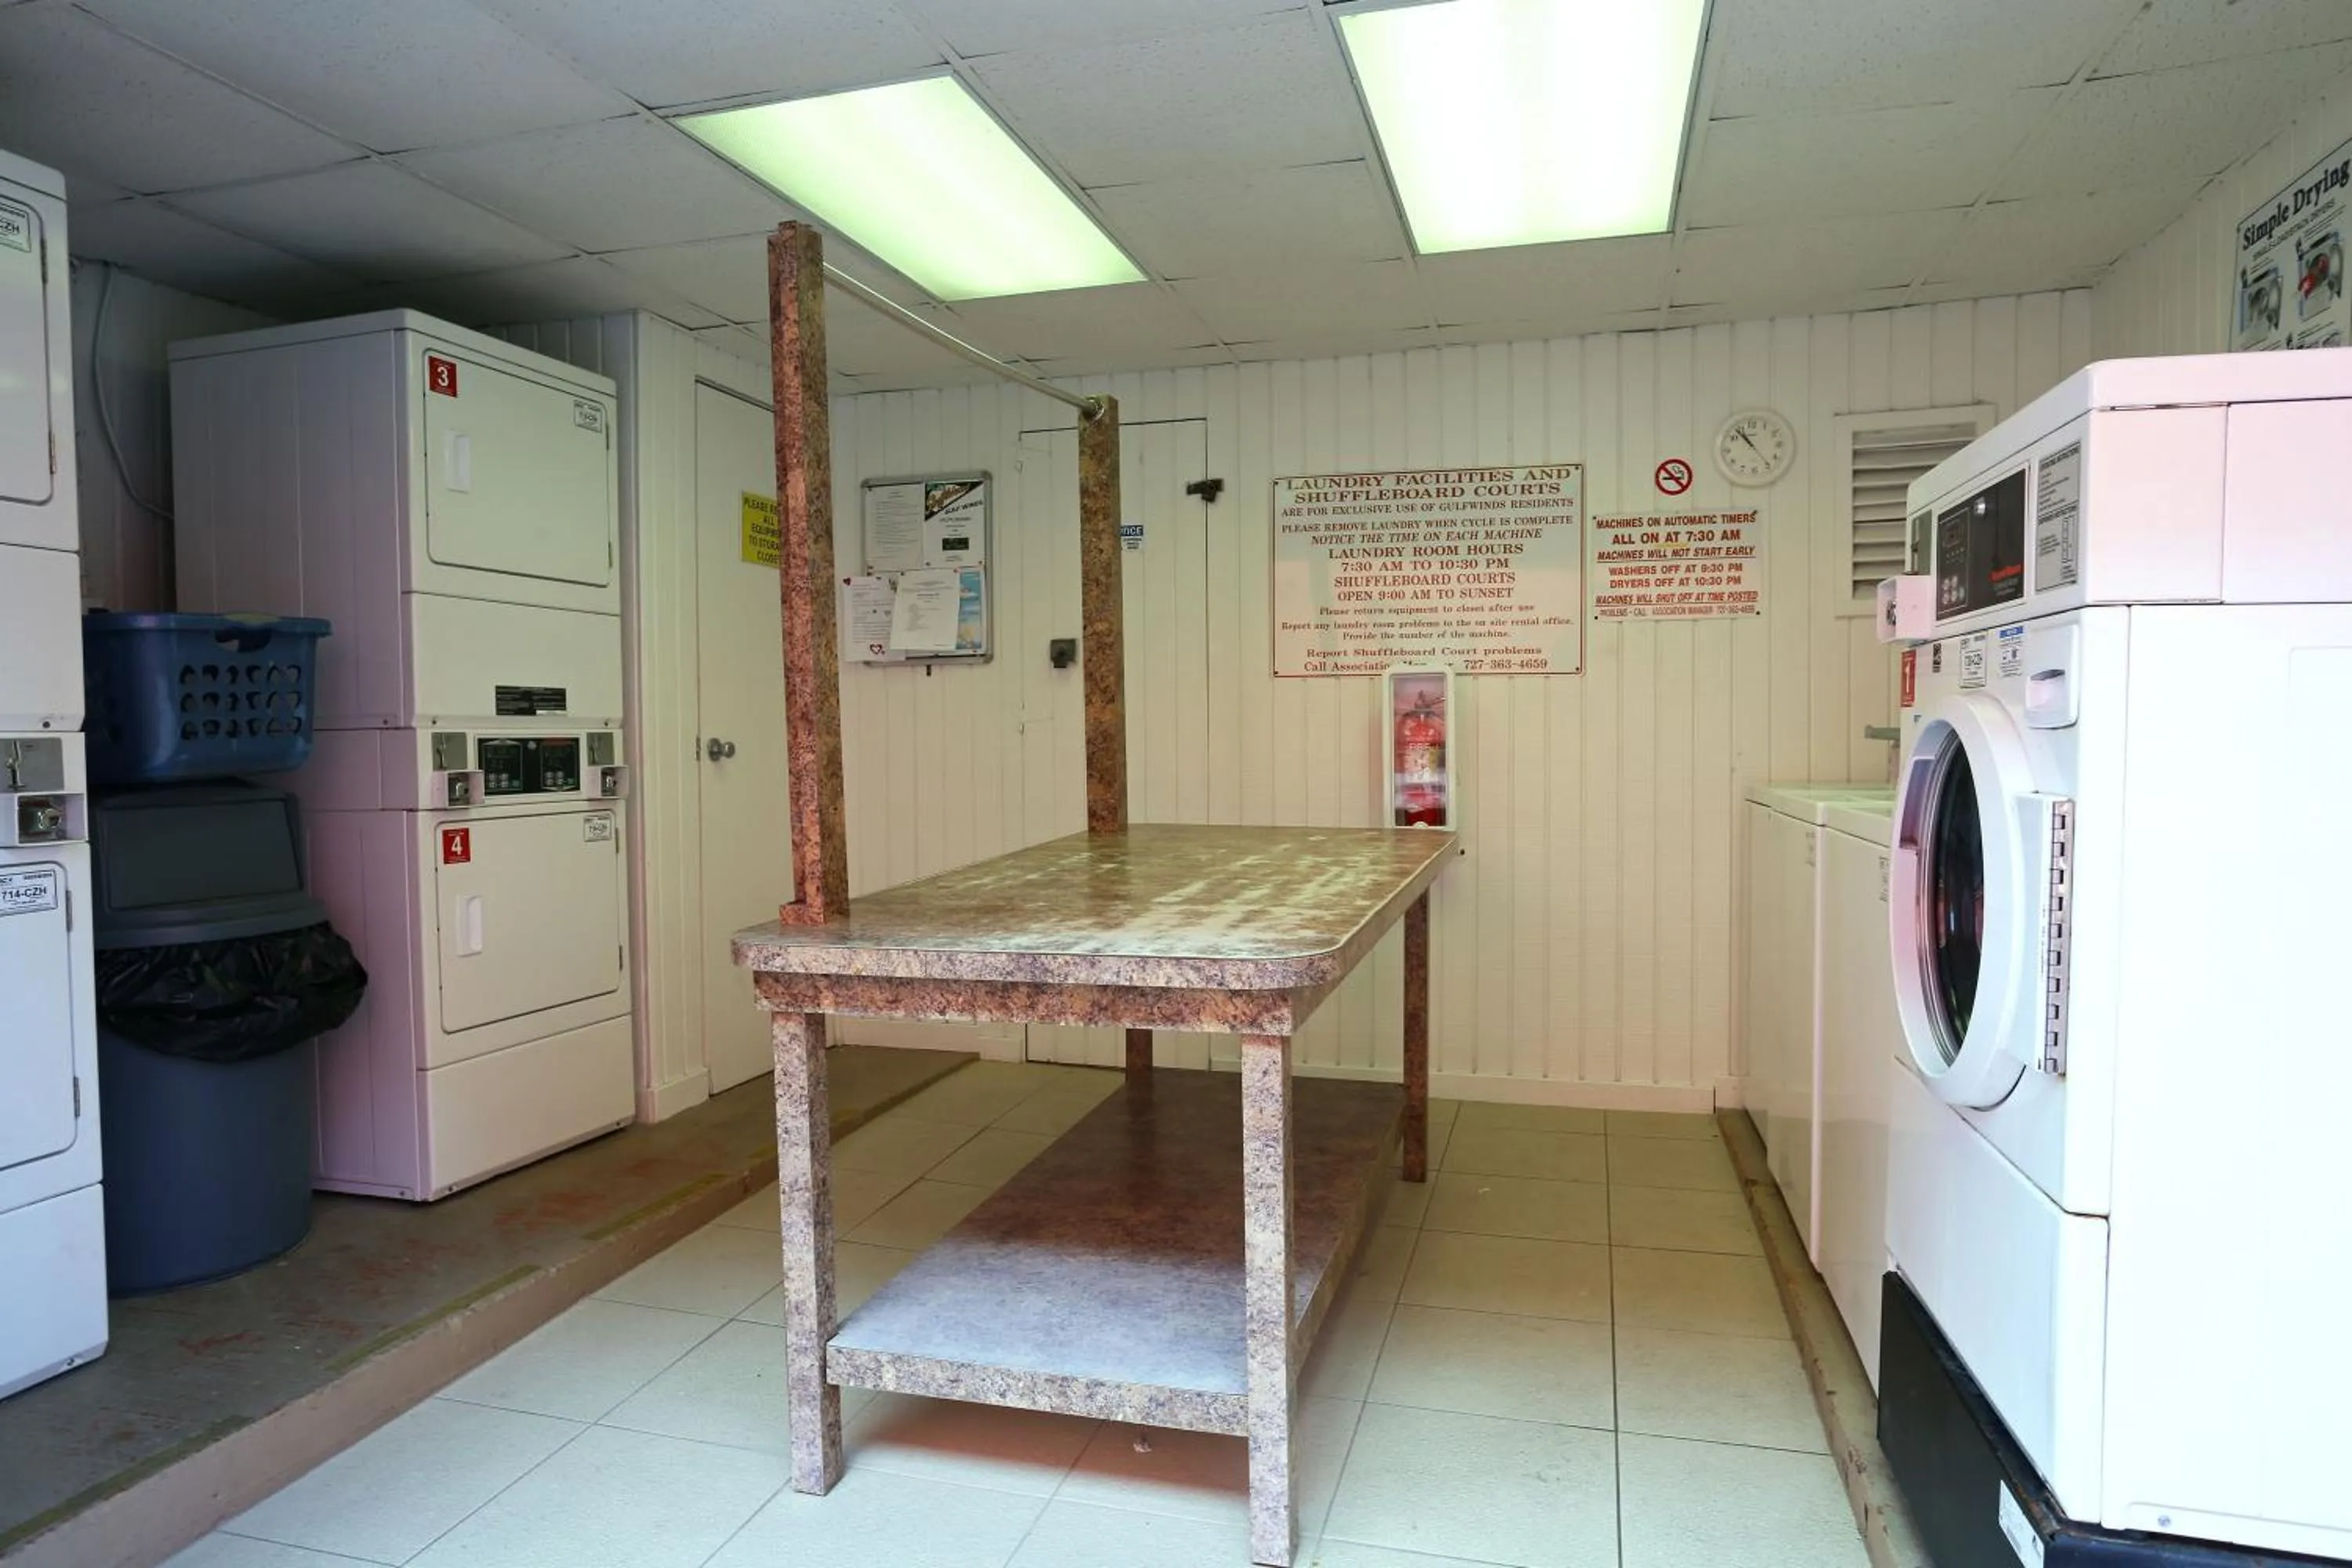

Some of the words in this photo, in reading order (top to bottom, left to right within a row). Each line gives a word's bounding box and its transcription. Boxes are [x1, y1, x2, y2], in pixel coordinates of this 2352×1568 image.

[2243, 202, 2289, 251] Simple
[2292, 158, 2350, 215] Drying
[437, 366, 448, 387] 3
[1287, 476, 1385, 490] LAUNDRY
[1394, 470, 1514, 485] FACILITIES
[1524, 468, 1571, 481] AND
[1294, 486, 1465, 503] SHUFFLEBOARD
[1474, 482, 1561, 497] COURTS
[1282, 507, 1303, 517] ARE
[1307, 506, 1328, 516] FOR
[1332, 504, 1392, 515] EXCLUSIVE
[1396, 503, 1418, 514] USE
[1421, 503, 1434, 511] OF
[1439, 500, 1506, 510] GULFWINDS
[1511, 498, 1573, 509] RESIDENTS
[1282, 523, 1321, 533] PLEASE
[1324, 521, 1367, 532] REMOVE
[1371, 520, 1421, 531] LAUNDRY
[1425, 519, 1457, 528] WHEN
[1461, 517, 1496, 527] CYCLE
[1500, 517, 1511, 526] IS
[1514, 515, 1573, 526] COMPLETE
[1596, 517, 1644, 528] MACHINES
[1647, 517, 1661, 528] ON
[1664, 514, 1717, 526] AUTOMATIC
[1721, 514, 1756, 524] TIMERS
[1311, 534, 1356, 545] NOTICE
[1360, 534, 1385, 543] THE
[1388, 532, 1420, 543] TIME
[1423, 532, 1442, 541] ON
[1446, 530, 1479, 541] EACH
[1483, 528, 1543, 539] MACHINE
[1612, 533, 1635, 544] ALL
[1640, 532, 1659, 544] ON
[1664, 532, 1681, 543] AT
[1686, 530, 1715, 542] 7:30
[1720, 529, 1740, 541] AM
[1328, 546, 1405, 559] LAUNDRY
[1413, 545, 1459, 557] ROOM
[1467, 543, 1524, 555] HOURS
[1597, 550, 1644, 560] MACHINES
[1647, 549, 1668, 558] WILL
[1671, 548, 1690, 557] NOT
[1693, 547, 1722, 557] START
[1726, 546, 1755, 556] EARLY
[1341, 561, 1372, 572] 7:30
[1379, 561, 1403, 572] AM
[1410, 560, 1432, 571] TO
[1439, 559, 1479, 570] 10:30
[1486, 558, 1510, 568] PM
[1609, 565, 1657, 576] WASHERS
[1661, 564, 1680, 574] OFF
[1685, 564, 1697, 573] AT
[1728, 563, 1743, 572] PM
[1334, 573, 1450, 587] SHUFFLEBOARD
[1457, 572, 1516, 584] COURTS
[1610, 579, 1650, 589] DRYERS
[1655, 578, 1675, 587] OFF
[1679, 577, 1690, 586] AT
[1694, 576, 1722, 586] 10:30
[1726, 575, 1741, 585] PM
[1337, 590, 1374, 601] OPEN
[1378, 590, 1405, 601] 9:00
[1410, 589, 1431, 600] AM
[1436, 589, 1454, 599] TO
[1459, 587, 1514, 598] SUNSET
[1596, 594, 1633, 604] MACHINES
[1636, 593, 1653, 603] WILL
[1656, 593, 1675, 603] SHUT
[1319, 606, 1350, 615] Please
[1388, 605, 1439, 615] equipment
[1488, 603, 1513, 612] after
[1511, 617, 1539, 626] rental
[1343, 632, 1377, 641] Provide
[1307, 649, 1348, 659] Report
[1353, 647, 1436, 658] Shuffleboard
[1441, 647, 1478, 655] Court
[1483, 646, 1542, 657] problems
[1304, 662, 1327, 672] Call
[1332, 660, 1390, 672] Associatio
[451, 835, 463, 855] 4
